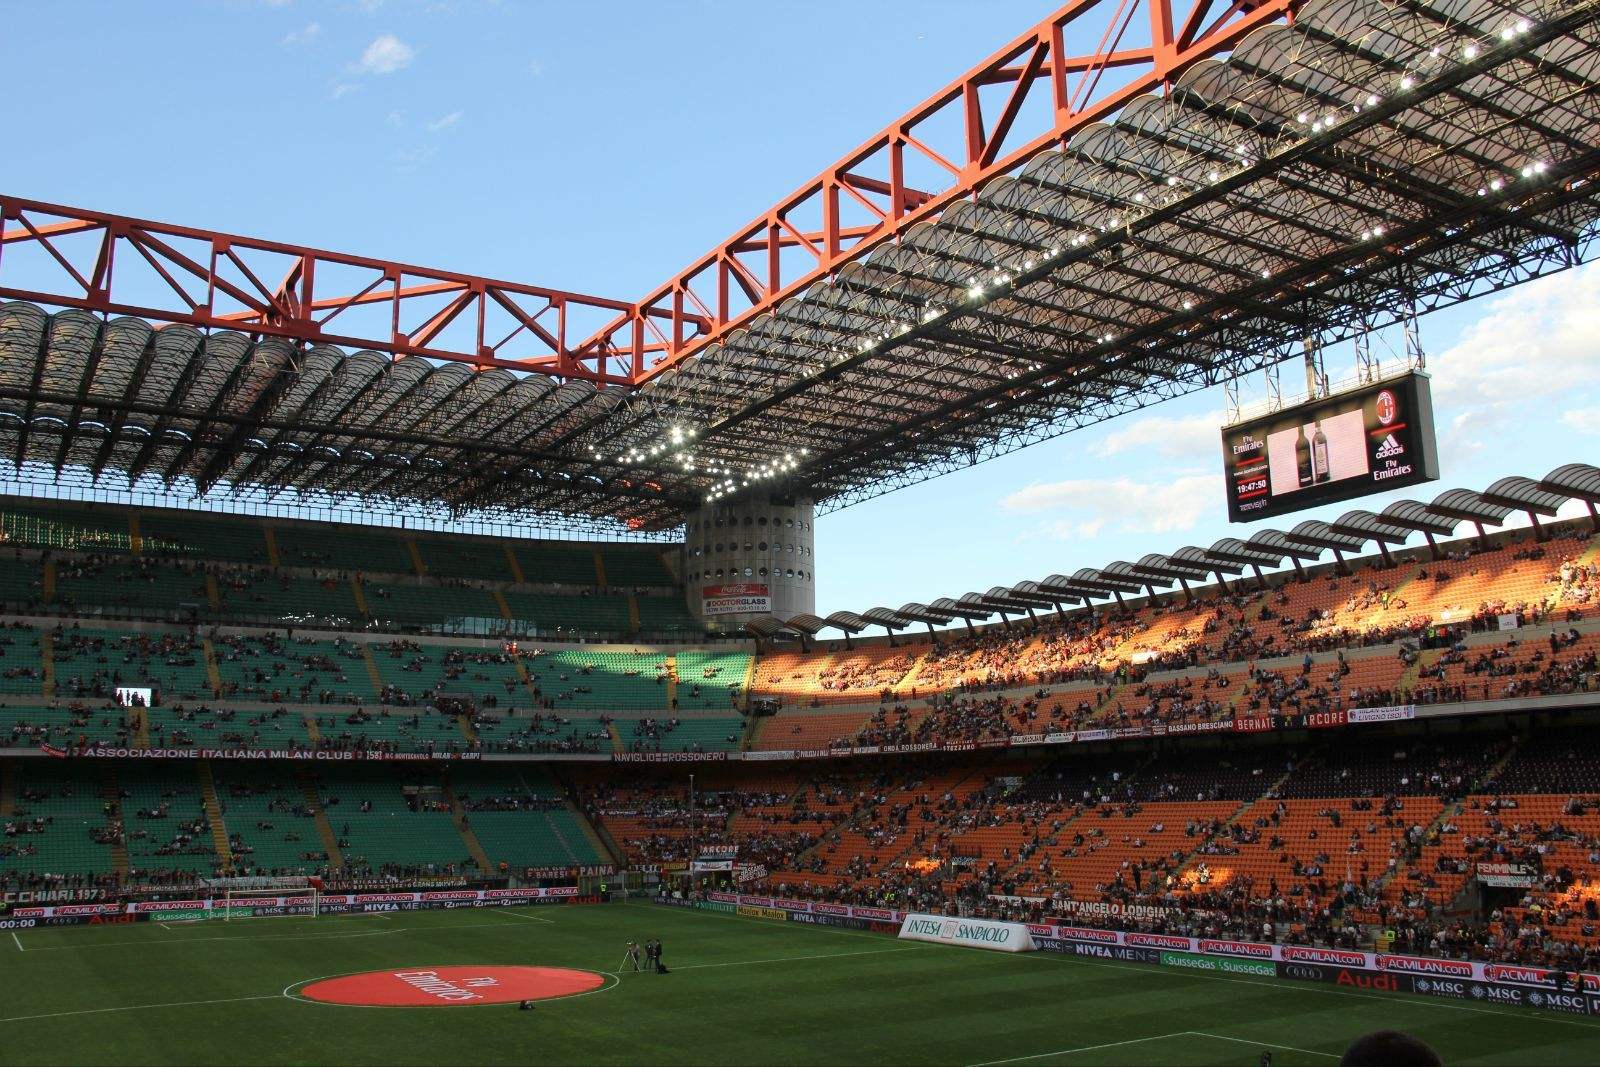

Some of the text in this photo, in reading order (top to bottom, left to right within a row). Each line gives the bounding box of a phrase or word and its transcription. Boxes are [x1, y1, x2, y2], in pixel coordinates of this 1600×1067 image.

[1233, 439, 1264, 455] Emirates
[1376, 444, 1404, 459] adidas
[1385, 460, 1397, 468] Fly
[1373, 464, 1411, 481] Emirates
[1237, 479, 1267, 493] 19:47:50
[1238, 717, 1276, 730] BERNATE
[1303, 712, 1344, 726] ARCORE
[1168, 723, 1196, 732] BASSANO
[1198, 721, 1233, 730] BRESCIANO
[84, 748, 353, 760] ASSOCIAZIONE ITALIANA MILAN CLUB
[901, 743, 936, 751] ROSSONERA
[614, 752, 725, 762] NAVIGLIO ROSSONERO
[580, 865, 614, 876] PAINA
[1478, 863, 1526, 874] FEMMINILE
[429, 891, 477, 899] ACMILAN.com
[491, 889, 539, 897] ACMILAN.com
[144, 902, 203, 911] ACMILAN.com
[364, 902, 430, 911] NIVEA MEN
[1052, 900, 1119, 914] SANT'ANGELO
[794, 913, 815, 923] NIVEA
[908, 920, 1010, 943] INTESA SANPAOLO
[1065, 929, 1117, 942] ACMILAN.com
[1043, 940, 1061, 950] MSC
[1133, 936, 1190, 950] ACMILAN.com
[1207, 943, 1272, 957] ACMILAN.com
[1076, 943, 1146, 961] NIVEA MEN
[1293, 951, 1364, 965] ACMILAN.com
[1168, 955, 1216, 970] SuisseGas
[1223, 961, 1275, 976] SuisseGas
[1388, 960, 1471, 976] ACMILAN.com
[1336, 968, 1399, 992] Audi
[1433, 980, 1464, 994] MSC
[1487, 986, 1522, 1000] MSC
[1546, 993, 1584, 1009] MSC
